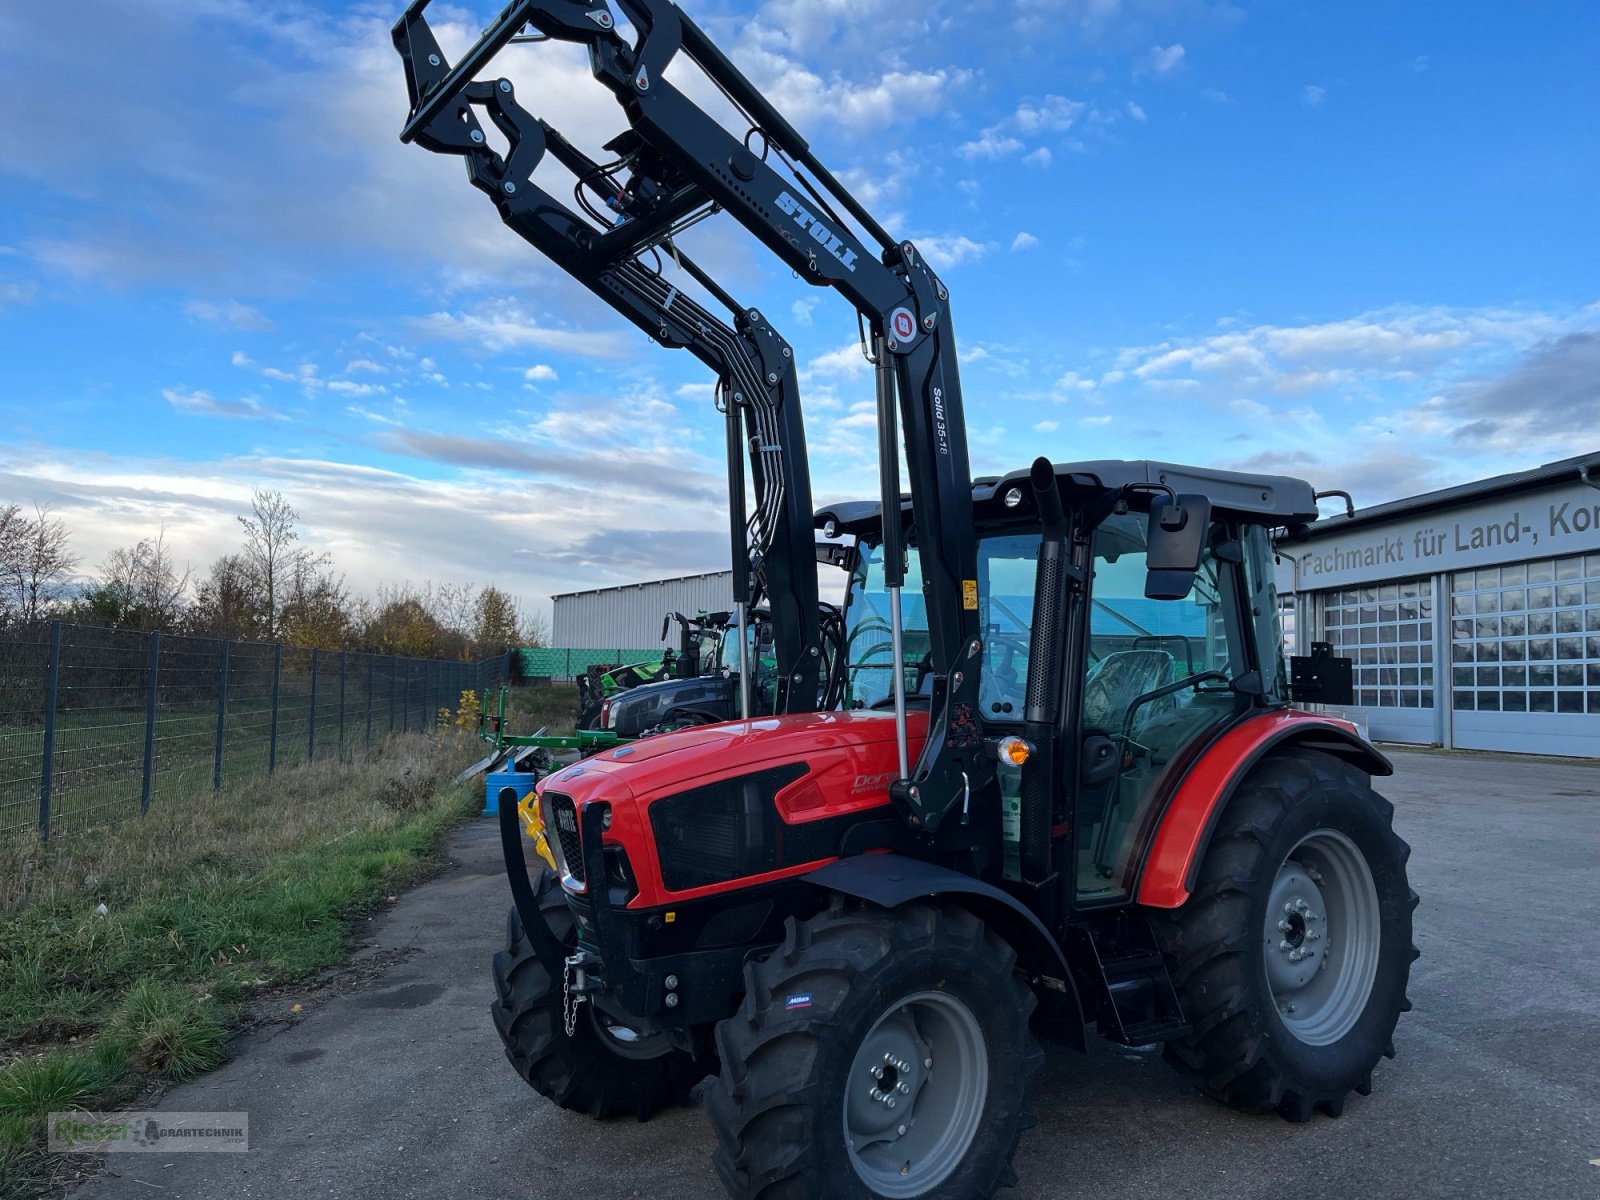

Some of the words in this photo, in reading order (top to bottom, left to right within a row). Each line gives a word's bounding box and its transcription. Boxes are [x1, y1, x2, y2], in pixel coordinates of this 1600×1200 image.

[774, 191, 858, 273] STOLL
[933, 387, 944, 420] Solid
[1303, 536, 1404, 576] Fachmarkt
[1413, 528, 1447, 558] für
[1455, 512, 1538, 552] Land-,
